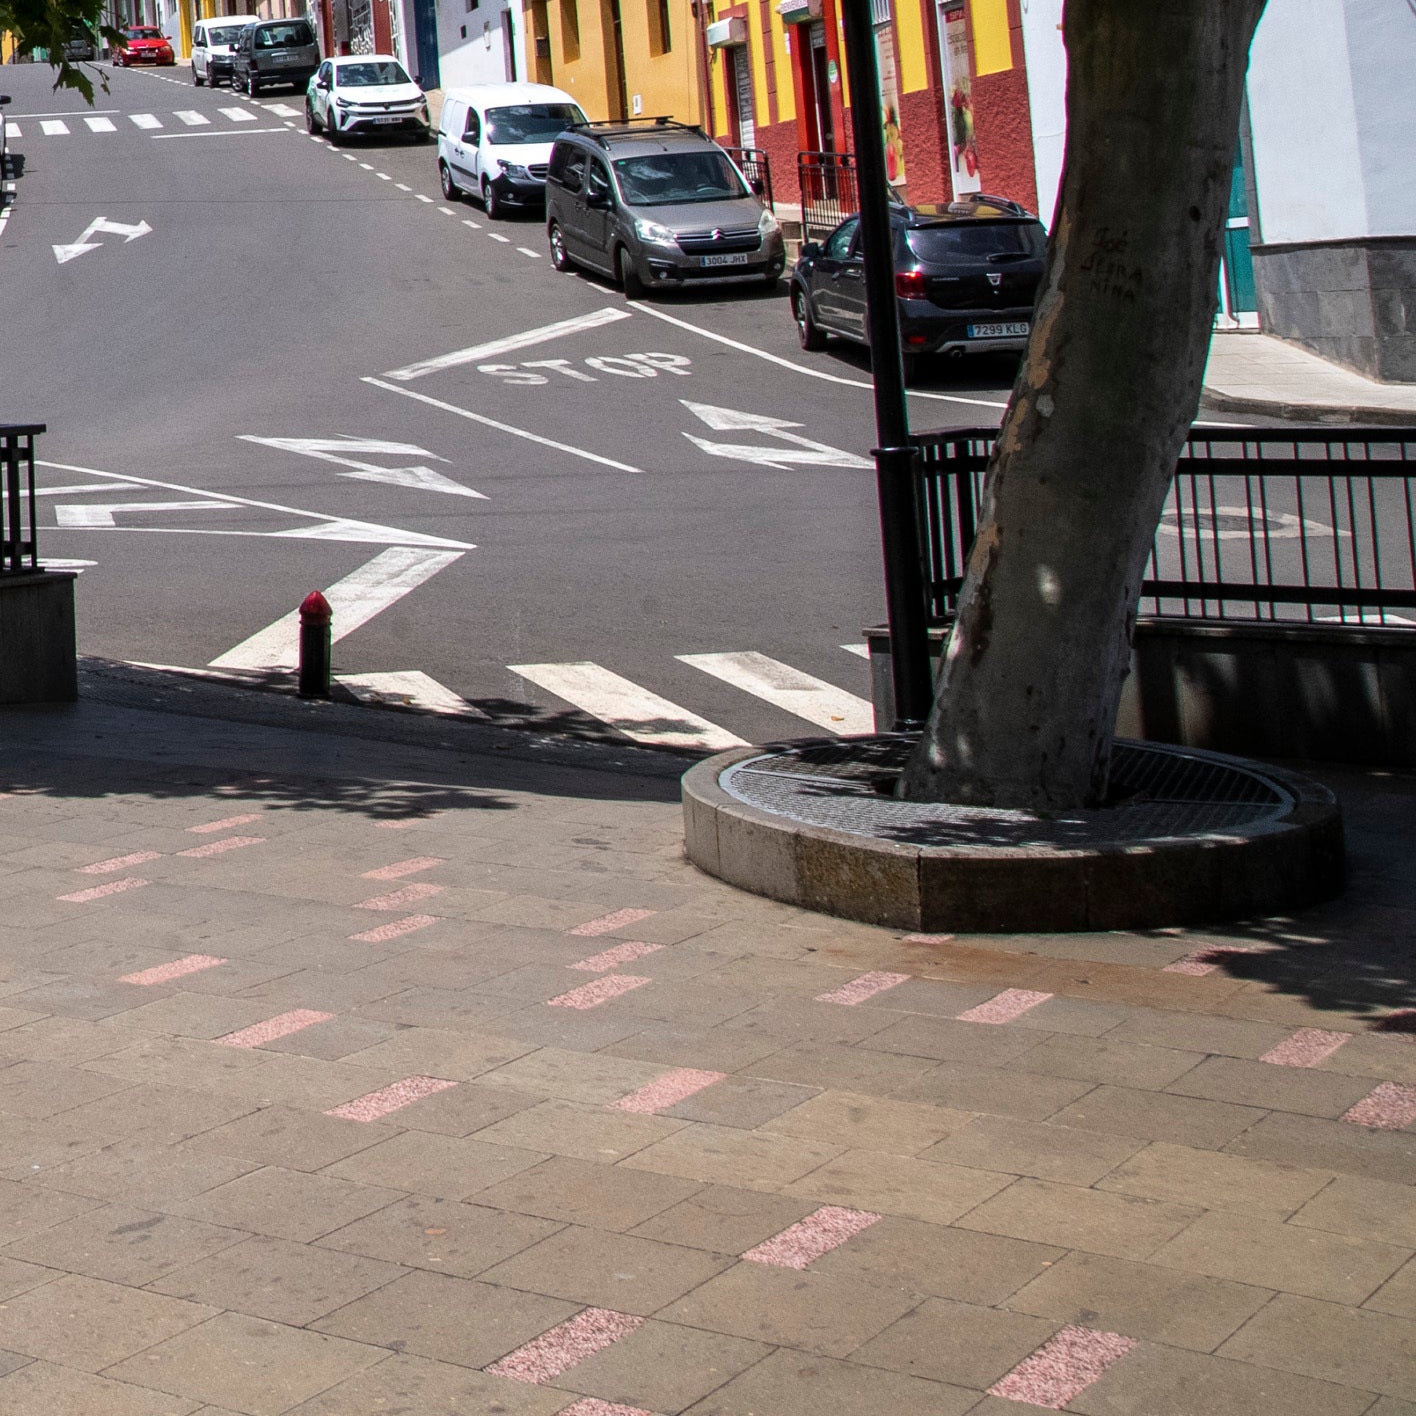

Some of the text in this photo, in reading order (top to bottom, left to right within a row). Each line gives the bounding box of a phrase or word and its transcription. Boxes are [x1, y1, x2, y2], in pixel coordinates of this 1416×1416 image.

[706, 255, 728, 265] 3004
[975, 324, 1003, 335] 7299
[476, 352, 694, 385] STOP
